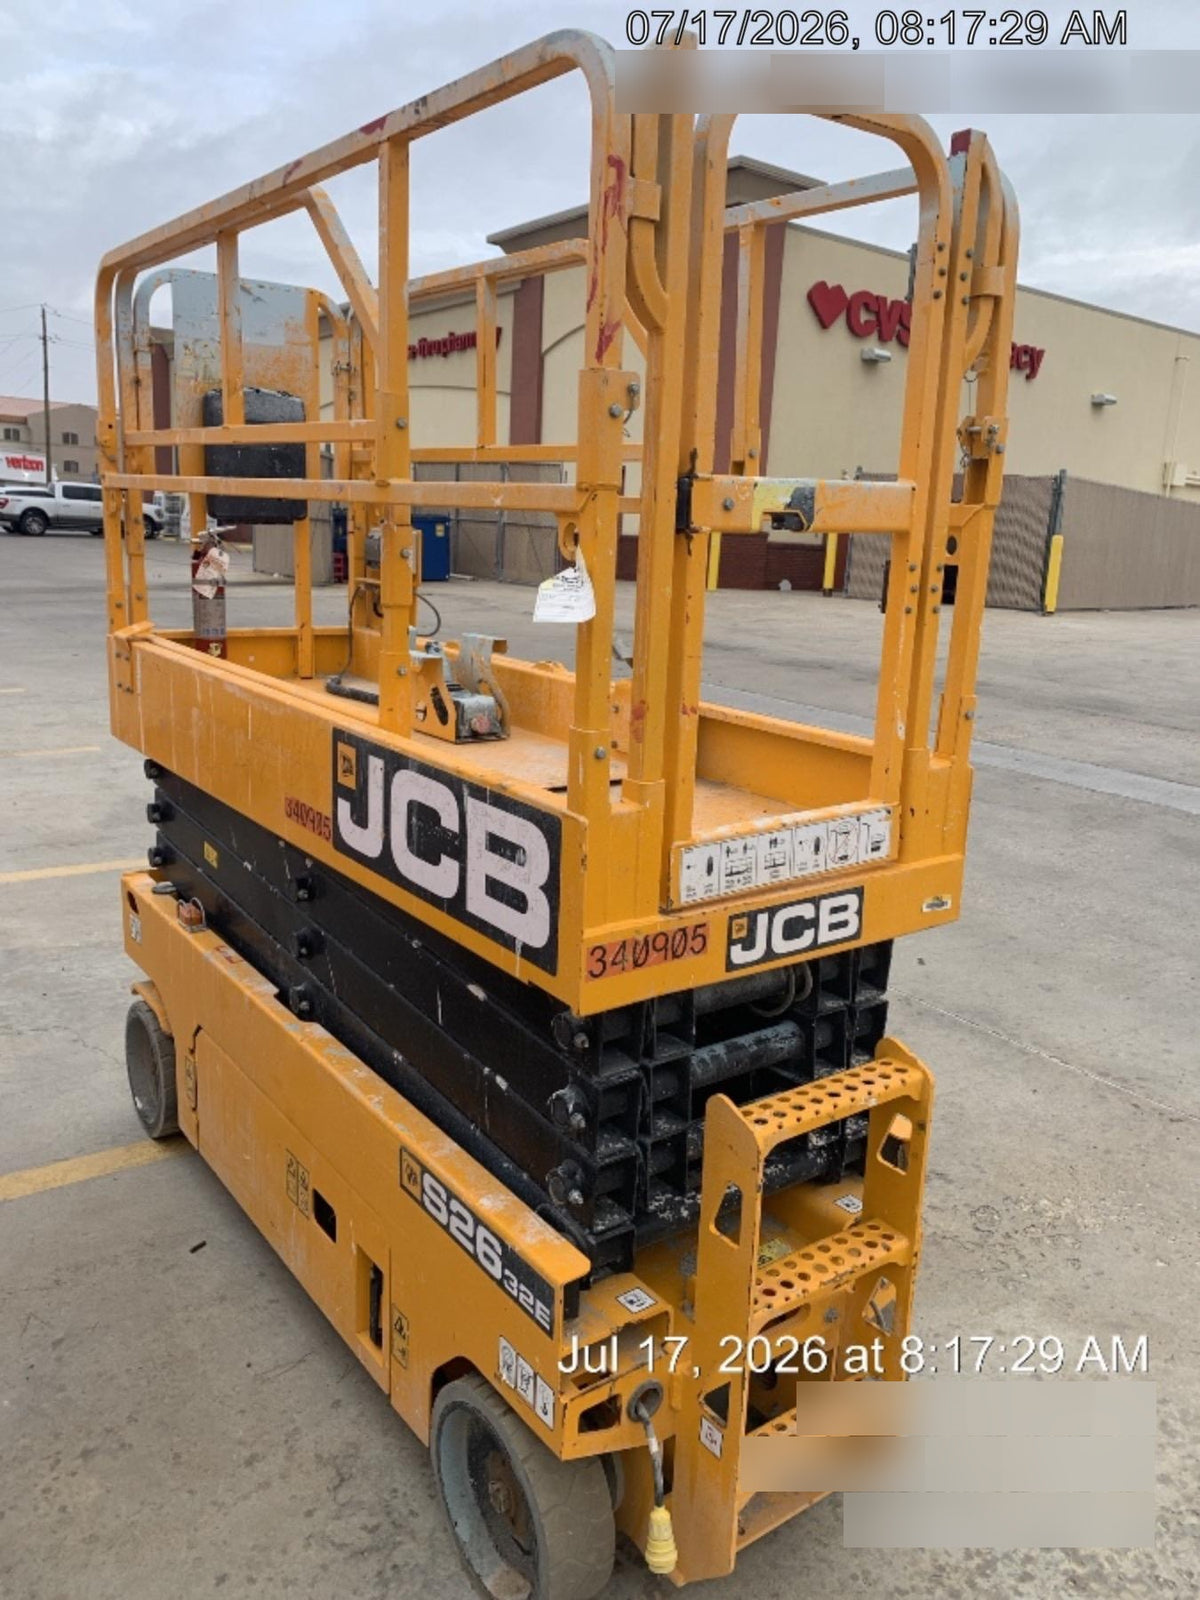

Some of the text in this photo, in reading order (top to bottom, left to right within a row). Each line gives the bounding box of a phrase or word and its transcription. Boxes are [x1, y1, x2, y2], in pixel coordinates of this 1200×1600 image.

[337, 755, 550, 949] JCB
[588, 922, 708, 979] 340905
[730, 893, 860, 965] JCB
